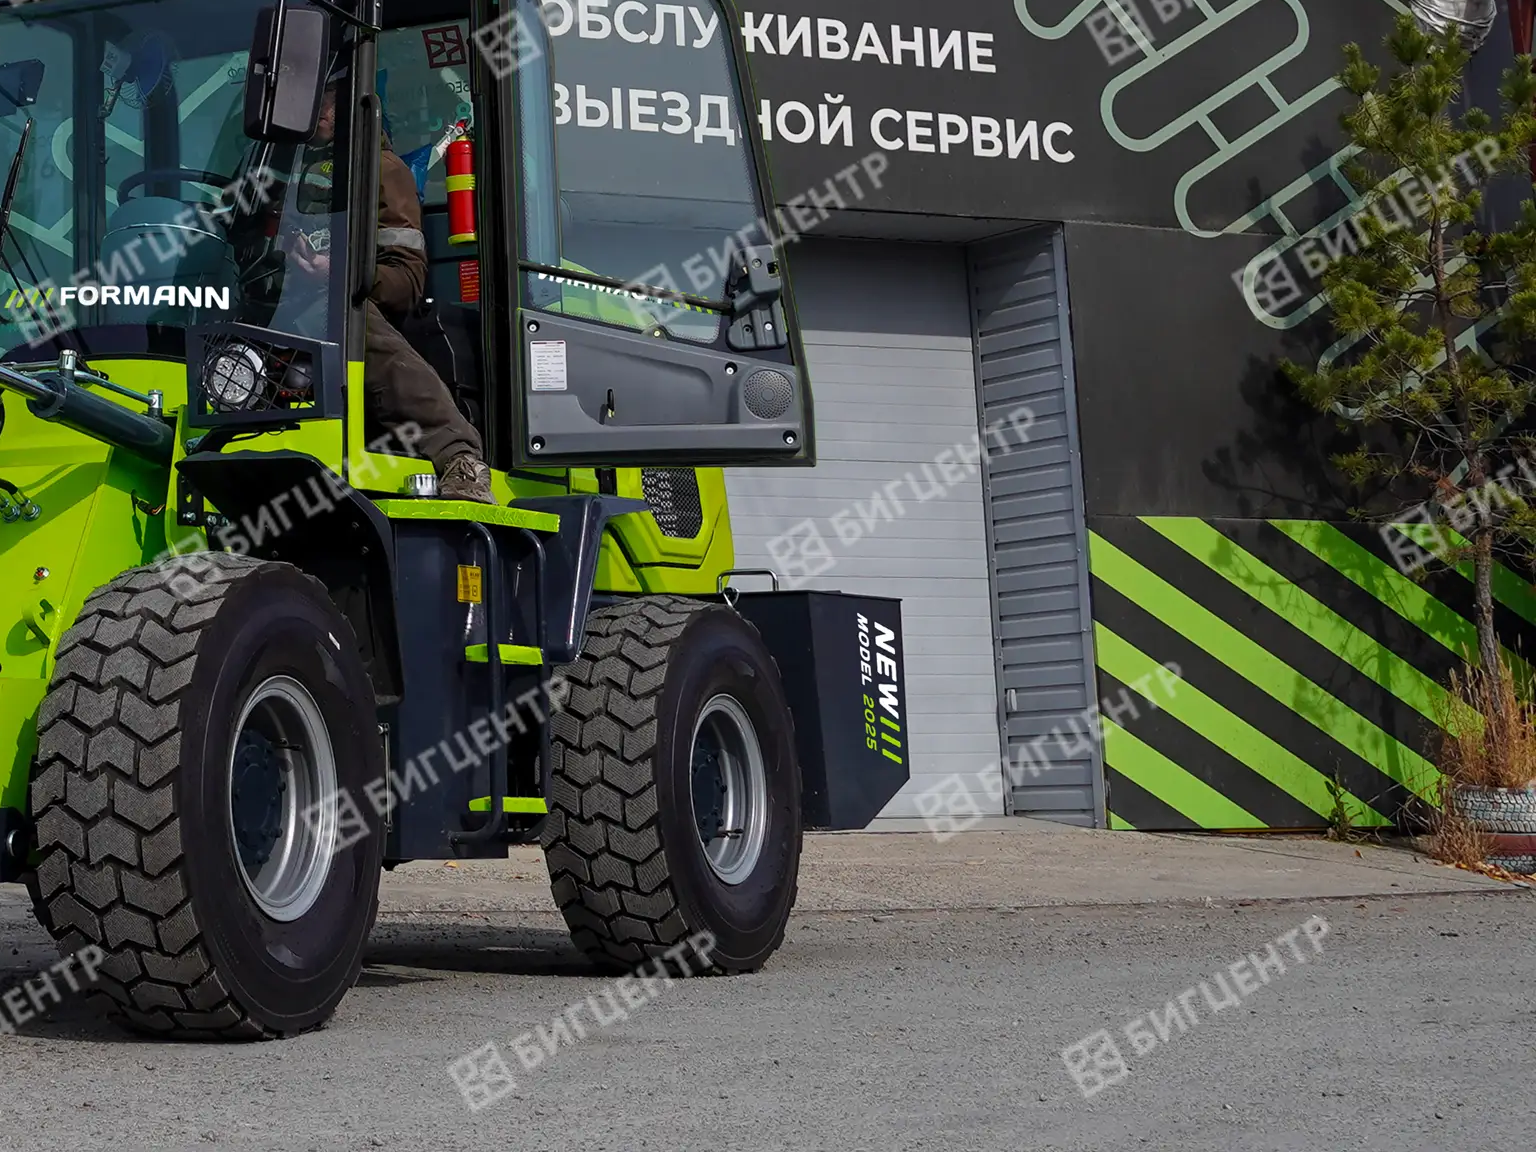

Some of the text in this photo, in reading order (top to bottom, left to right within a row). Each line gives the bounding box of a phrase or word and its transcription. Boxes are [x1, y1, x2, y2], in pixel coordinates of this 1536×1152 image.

[870, 108, 1075, 163] СЕРВИС
[60, 285, 231, 311] FORMANN
[856, 612, 878, 752] MODEL 2025
[874, 621, 899, 720] NEW
